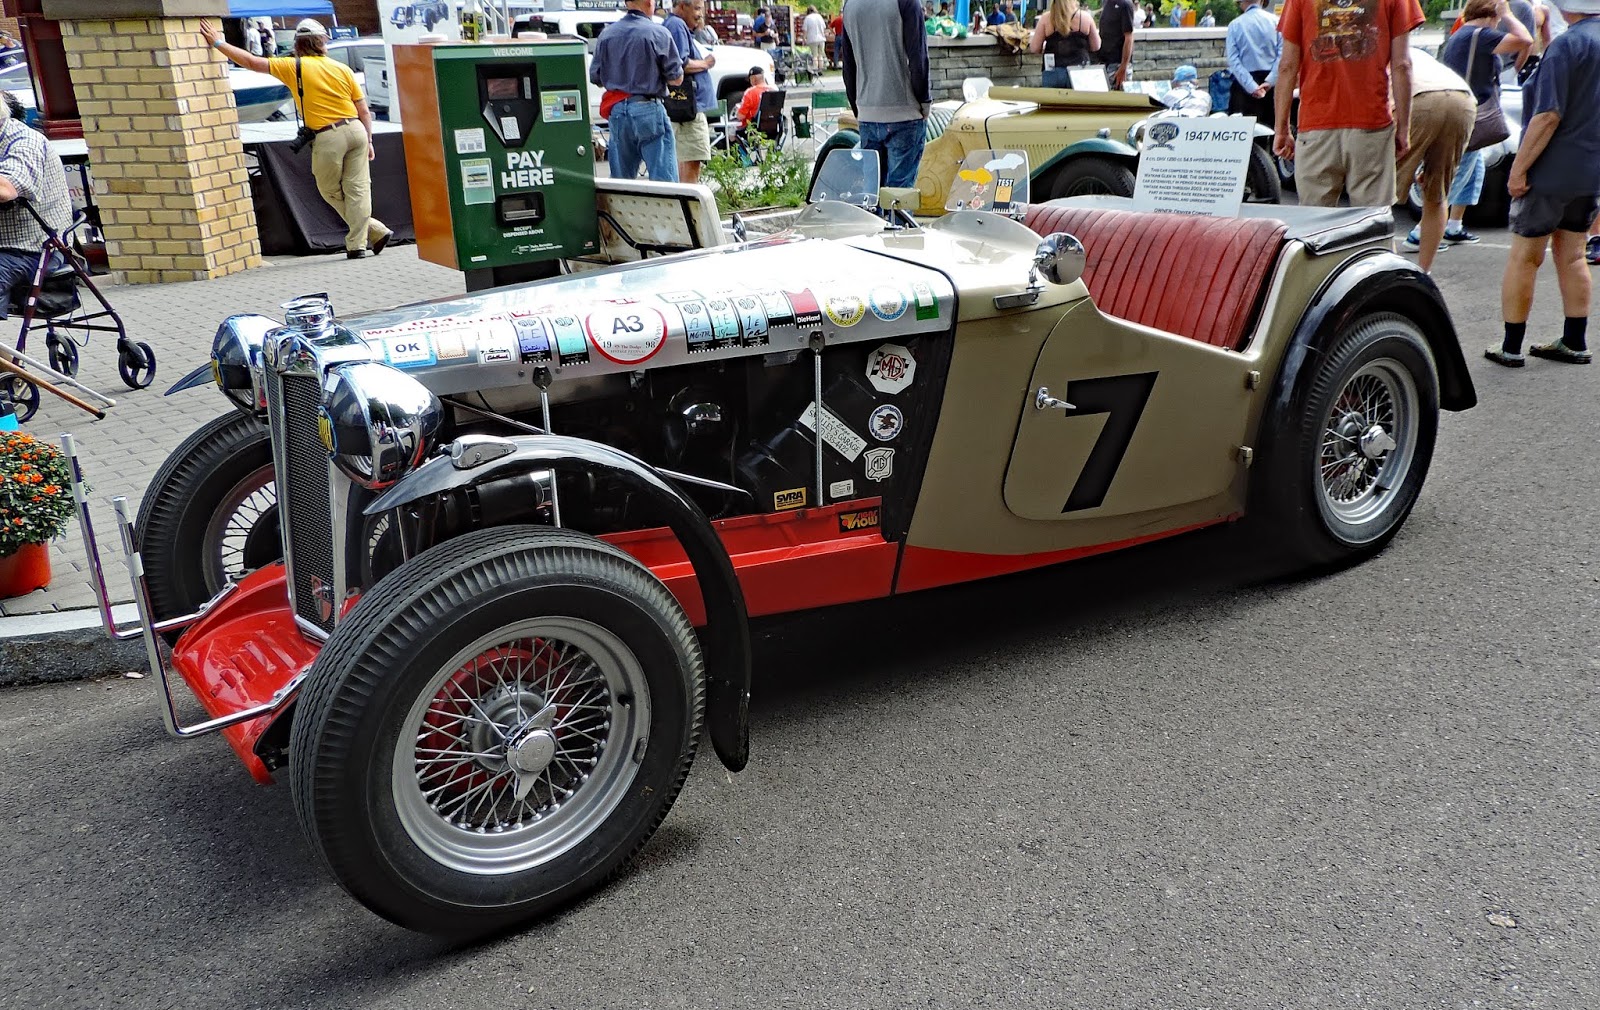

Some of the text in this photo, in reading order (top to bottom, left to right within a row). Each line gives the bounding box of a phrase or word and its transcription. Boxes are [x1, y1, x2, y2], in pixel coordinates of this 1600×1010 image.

[493, 48, 533, 56] WELCOME
[1185, 131, 1247, 141] 1947 MG-TC
[507, 150, 544, 170] PAY
[501, 168, 554, 188] HERE
[612, 315, 644, 334] A3
[797, 314, 820, 323] DieHard
[395, 342, 420, 353] OK
[825, 432, 849, 454] 535-4422
[838, 433, 860, 453] GARAGE
[1061, 371, 1159, 513] 7
[777, 491, 803, 502] SVRA
